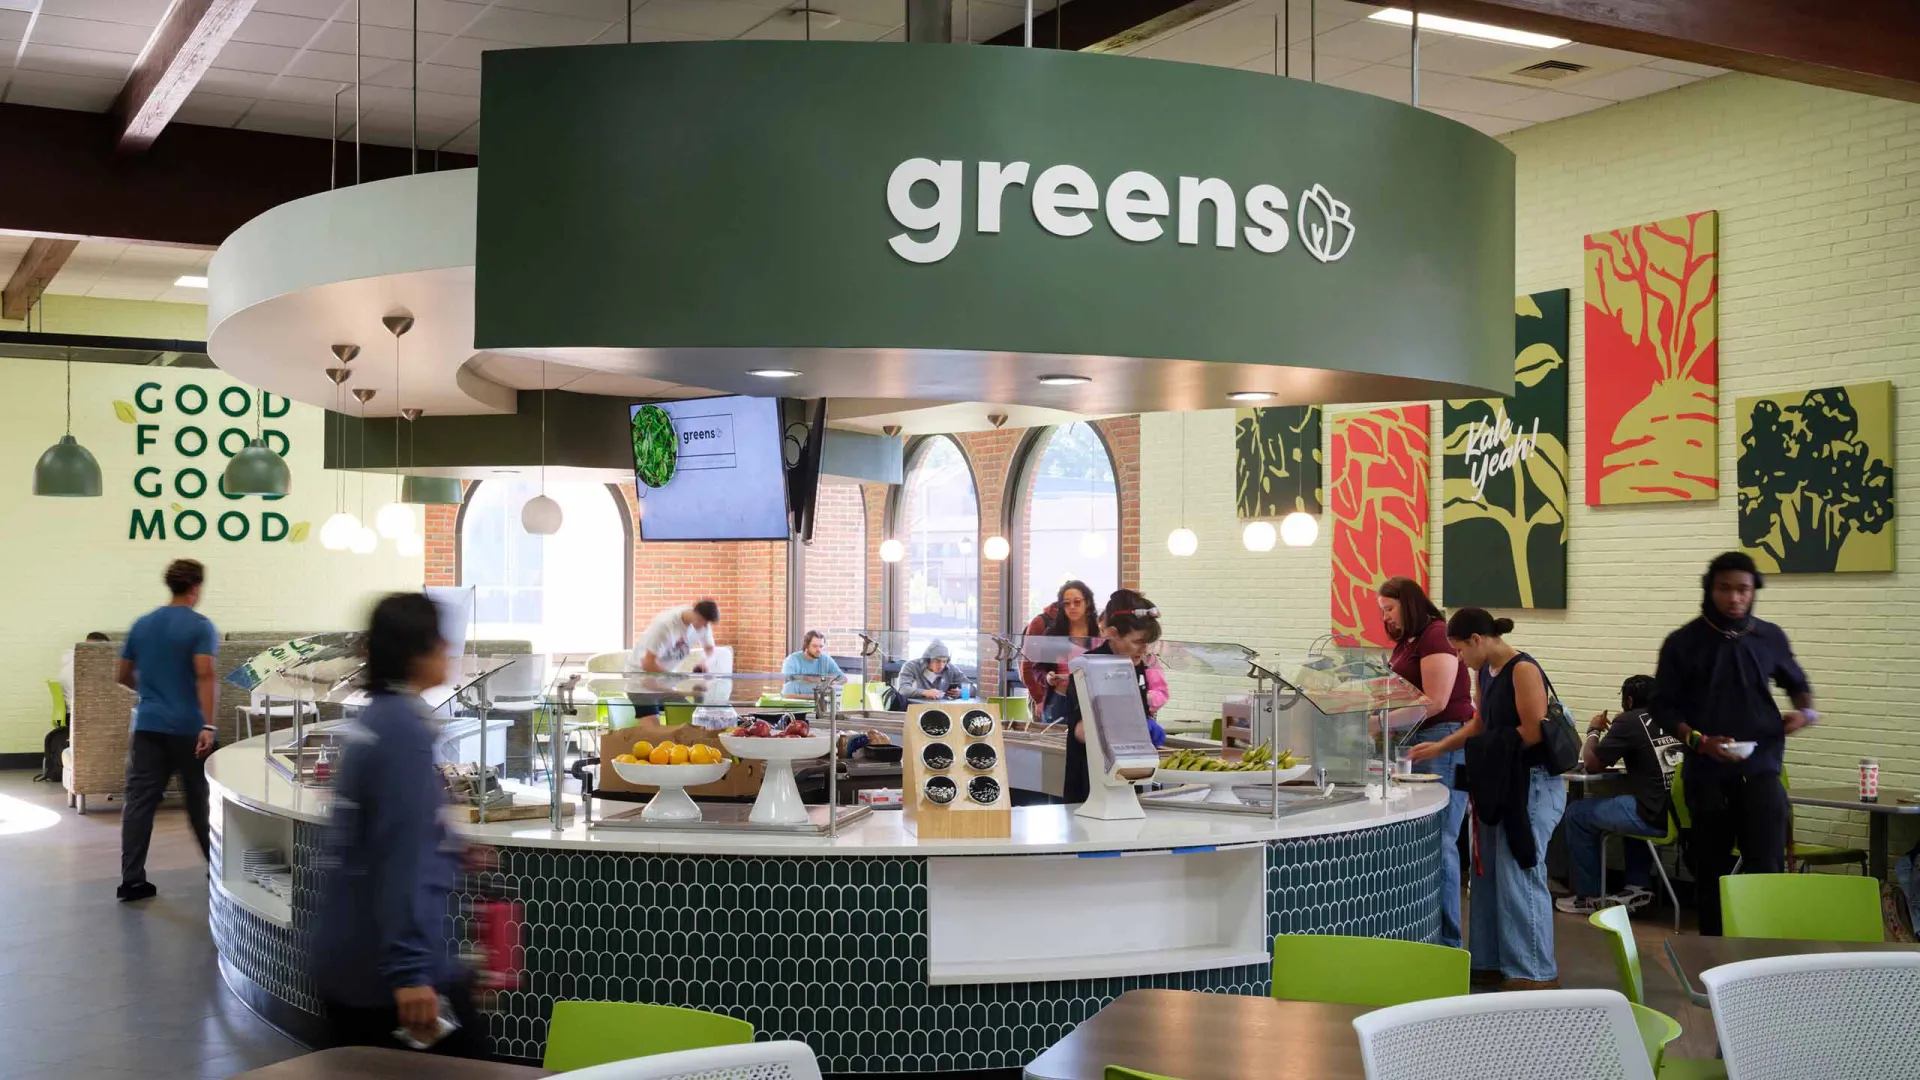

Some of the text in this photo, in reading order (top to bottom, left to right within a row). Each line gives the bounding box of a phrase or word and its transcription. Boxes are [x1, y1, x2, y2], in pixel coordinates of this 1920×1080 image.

[886, 157, 1289, 263] greens
[135, 382, 290, 418] GOOD
[137, 424, 290, 457] FOOD
[683, 429, 716, 444] greens
[1465, 406, 1514, 465] Kale
[134, 466, 287, 501] GO
[129, 508, 289, 542] MOOD
